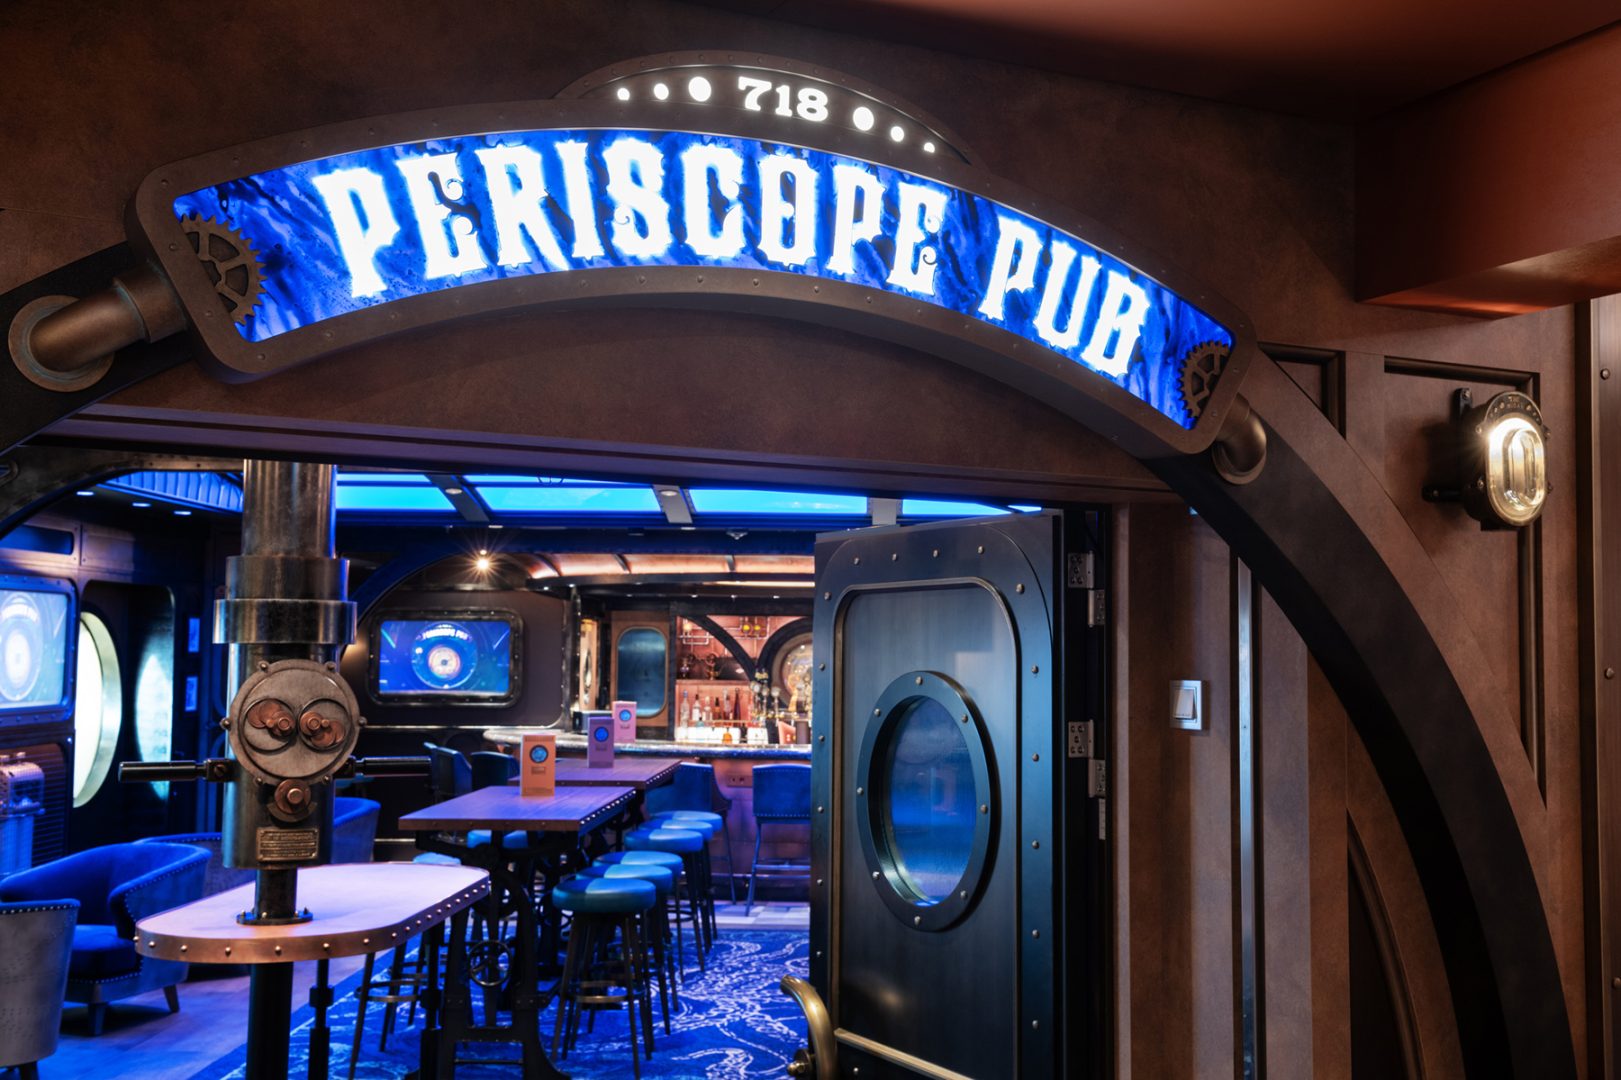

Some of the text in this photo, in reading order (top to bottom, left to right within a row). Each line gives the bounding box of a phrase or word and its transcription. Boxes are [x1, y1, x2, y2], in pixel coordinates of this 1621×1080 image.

[737, 75, 829, 123] 718
[312, 137, 1151, 377] PERISCOPE PUB
